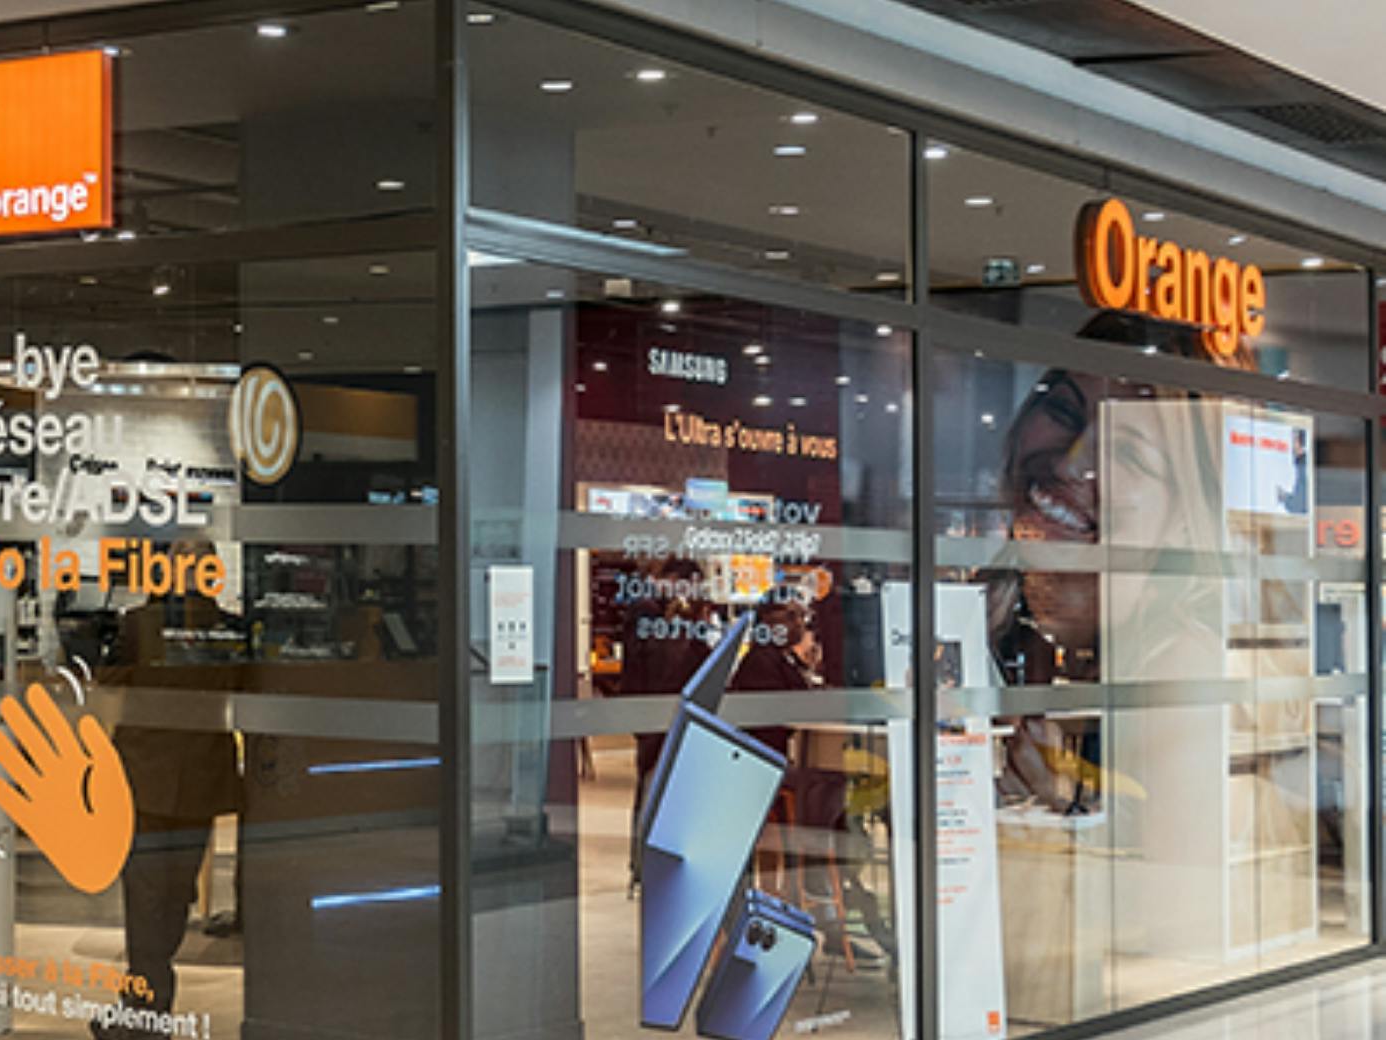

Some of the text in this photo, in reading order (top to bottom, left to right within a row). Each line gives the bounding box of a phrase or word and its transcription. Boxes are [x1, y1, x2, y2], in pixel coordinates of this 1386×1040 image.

[1088, 197, 1266, 357] Orange
[648, 347, 728, 385] SAMSUNG
[665, 411, 838, 460] L'Ultra s'ouvre à vous
[41, 535, 81, 591] la
[98, 537, 227, 598] Fibre
[45, 956, 57, 983] à
[63, 959, 84, 987] la
[89, 962, 155, 1003] Fibre,
[13, 985, 57, 1016] tout
[62, 992, 198, 1039] simplement
[202, 1012, 211, 1040] !
